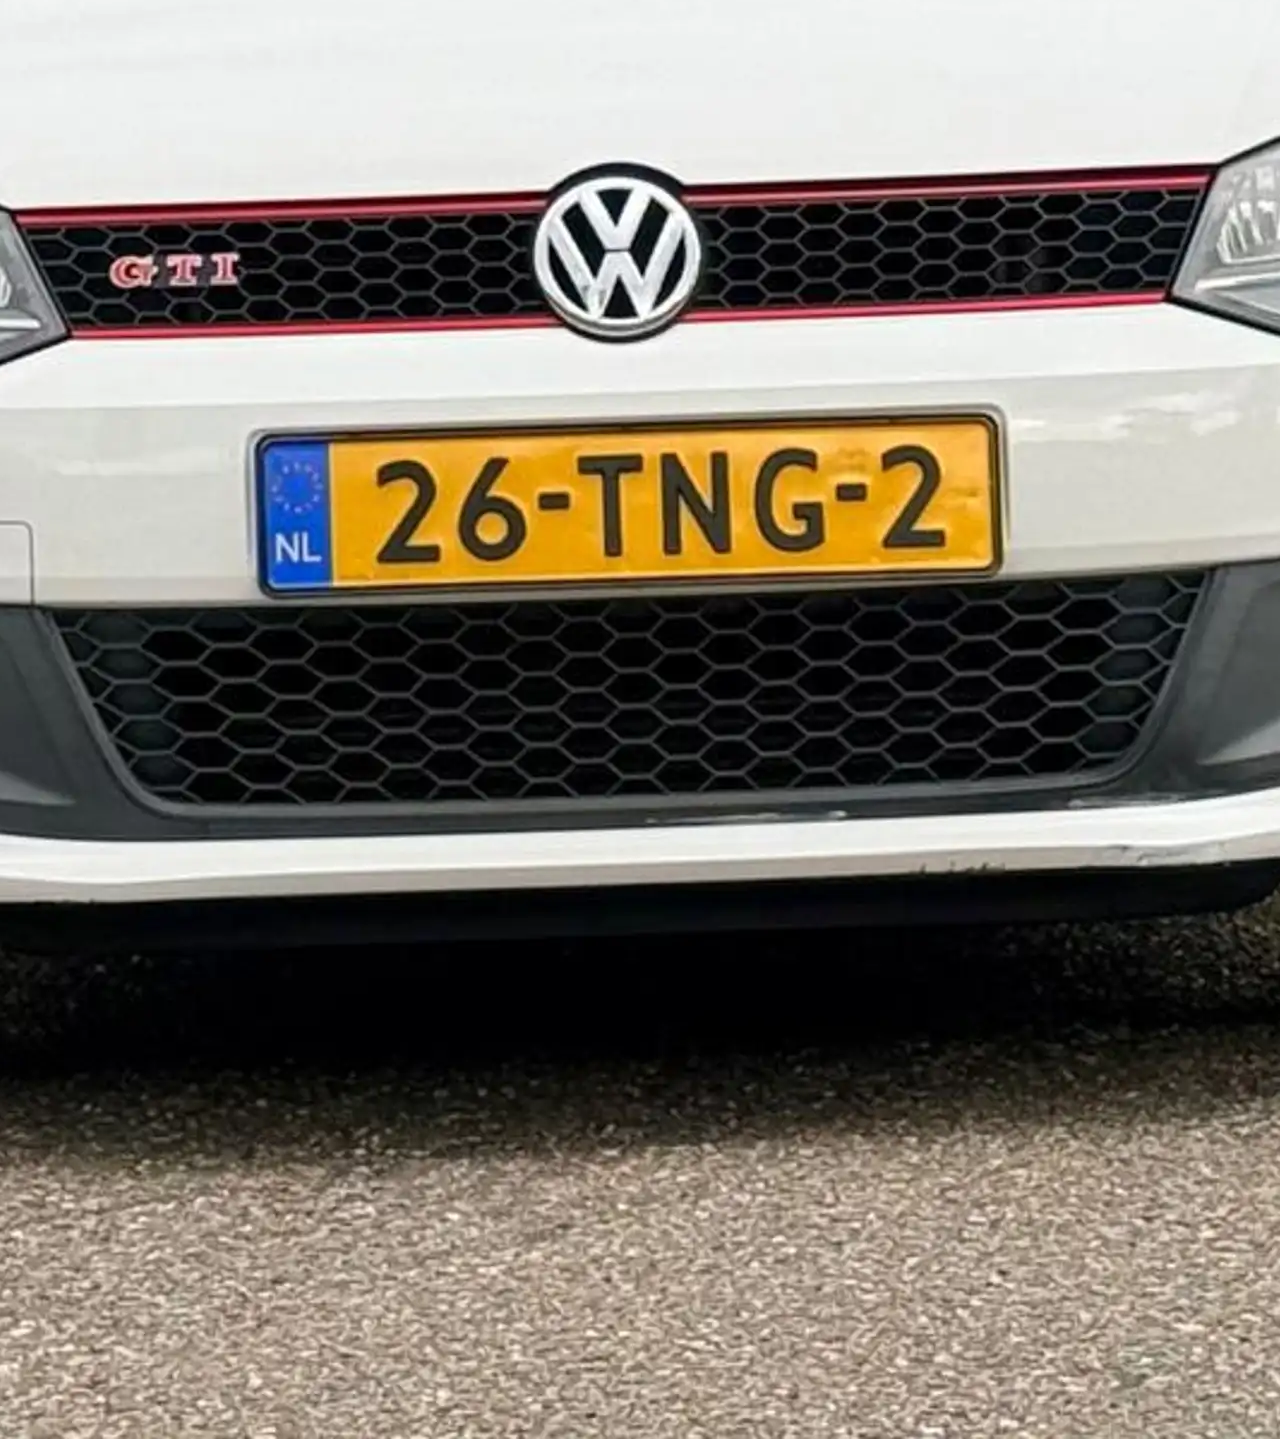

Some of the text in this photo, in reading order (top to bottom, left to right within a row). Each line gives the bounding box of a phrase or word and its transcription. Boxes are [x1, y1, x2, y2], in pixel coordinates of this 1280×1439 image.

[109, 252, 240, 289] GTI
[375, 445, 946, 564] 26-TNG-2
[275, 531, 322, 563] NL
